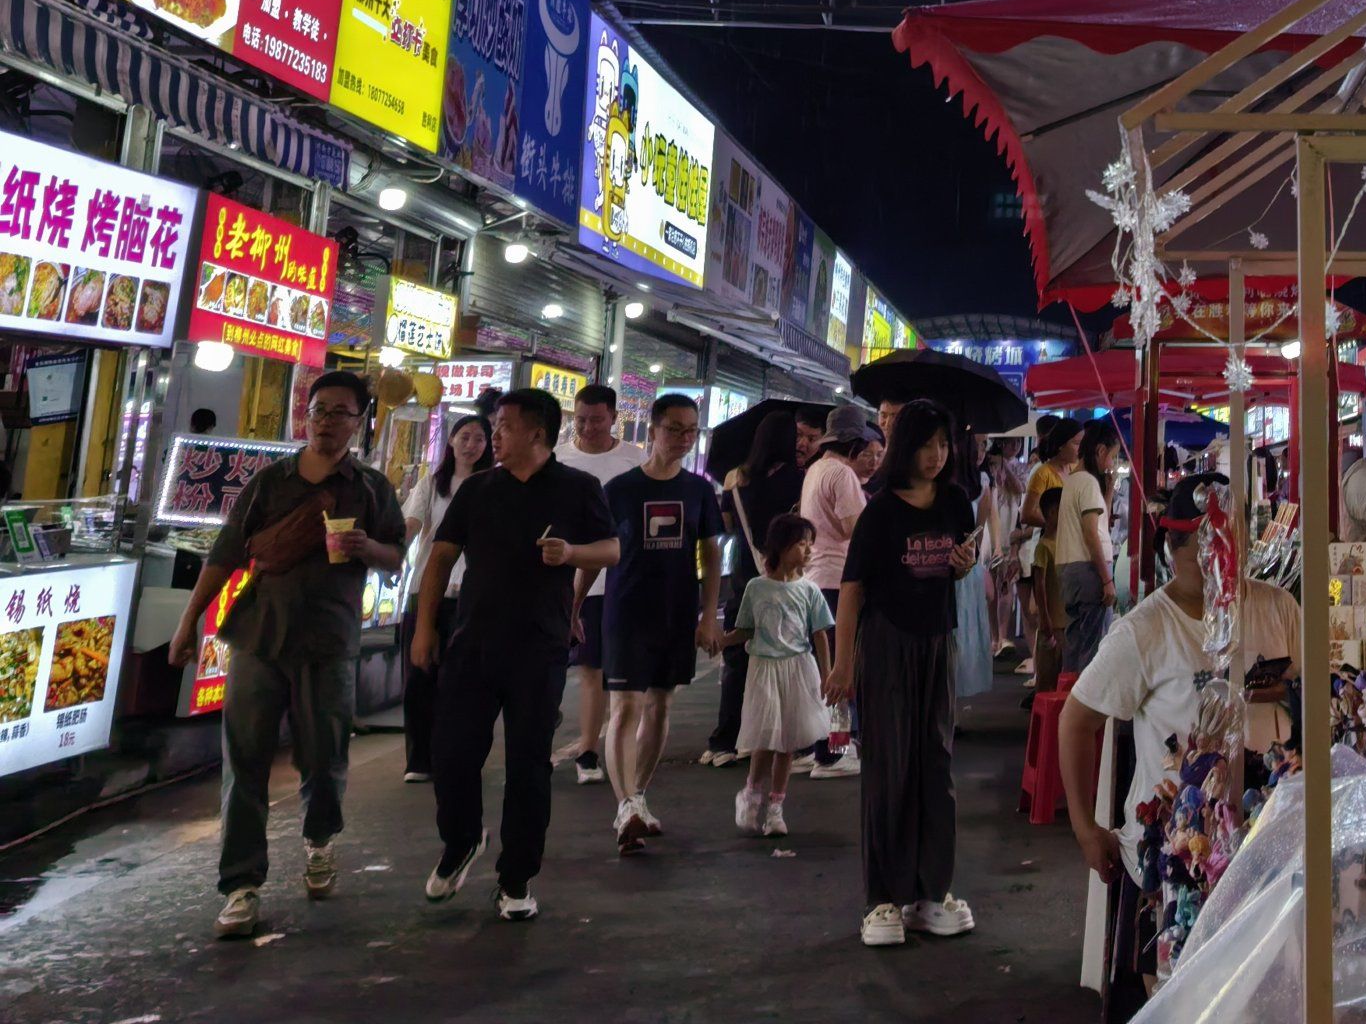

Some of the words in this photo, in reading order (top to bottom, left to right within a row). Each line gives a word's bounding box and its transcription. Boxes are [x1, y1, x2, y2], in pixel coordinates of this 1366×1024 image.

[81, 188, 184, 270] 烤脑花
[932, 342, 1024, 366] 利烧烤城
[5, 583, 82, 625] 锡纸烧
